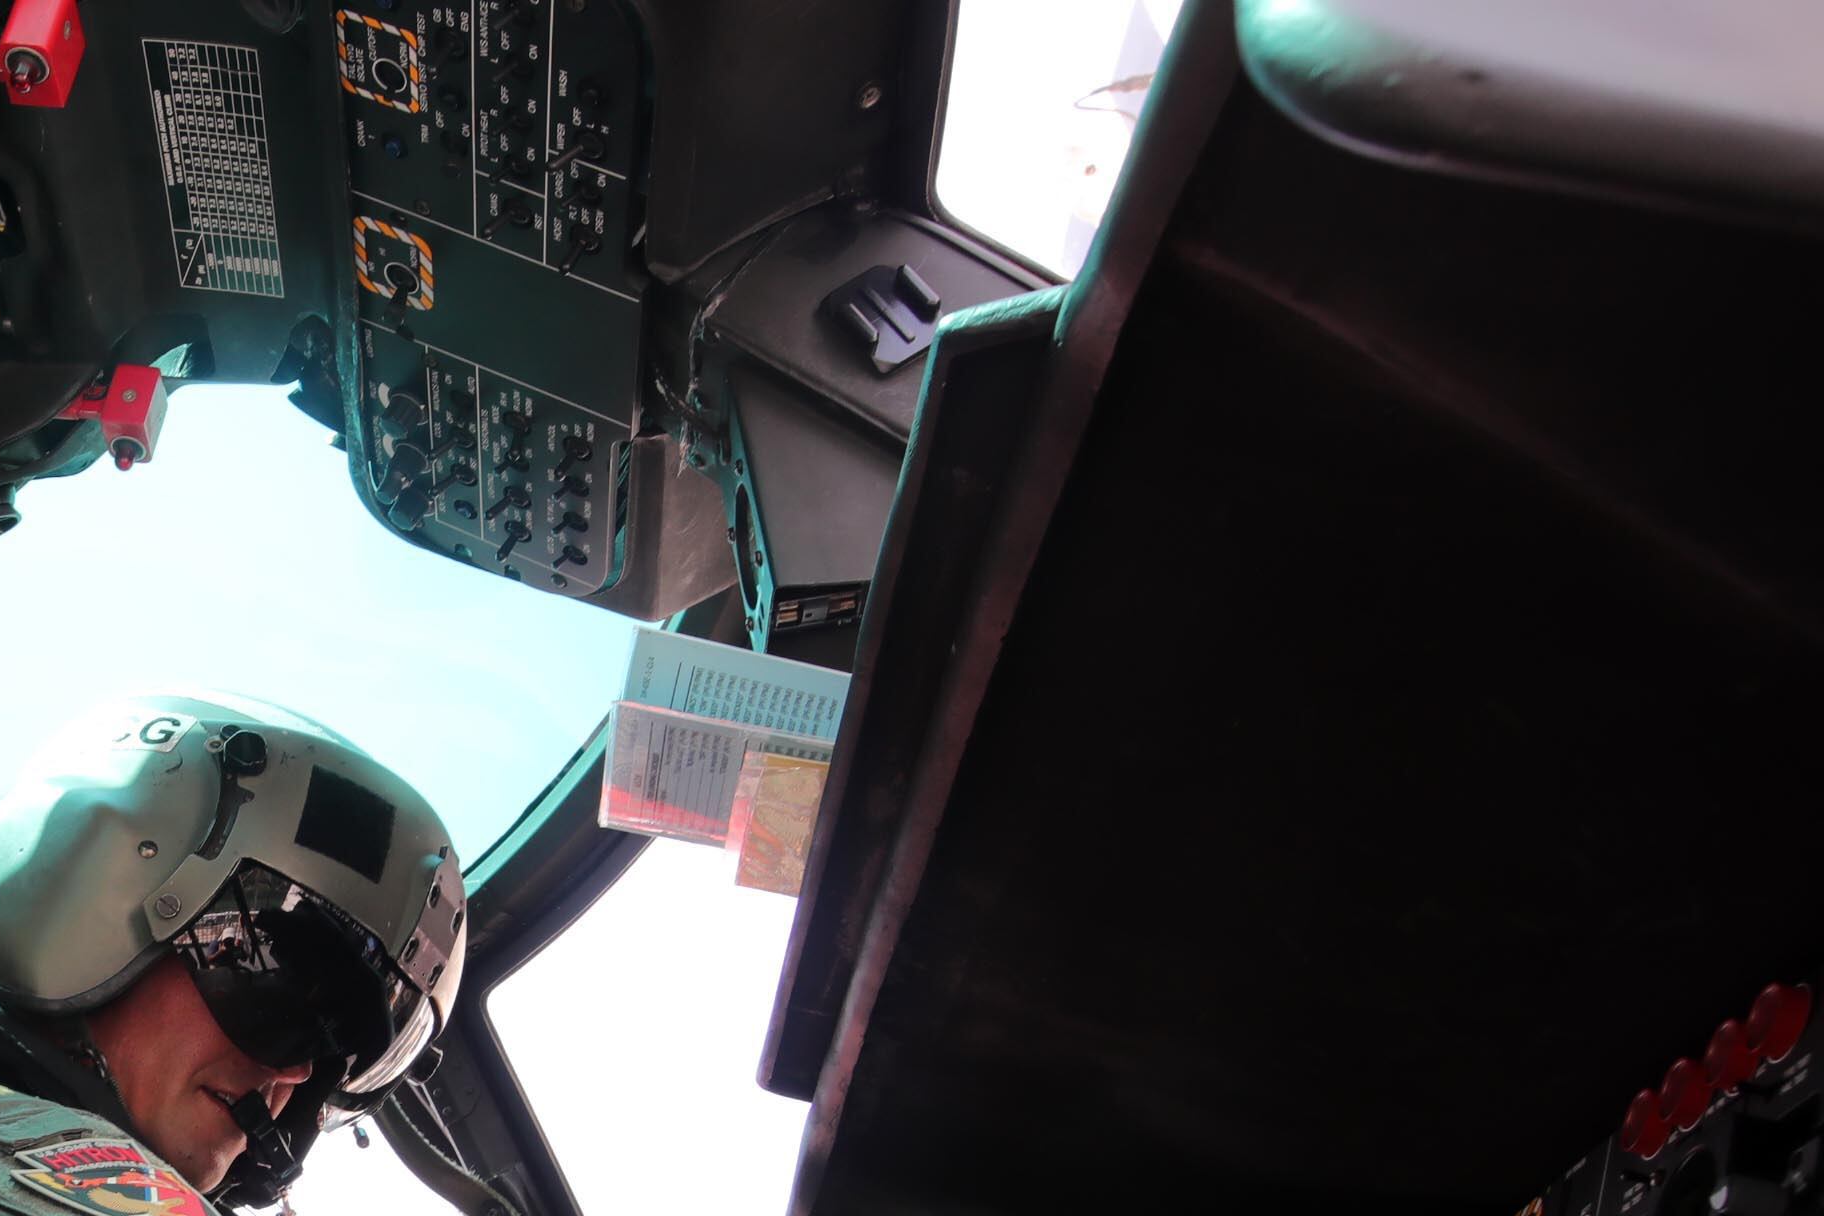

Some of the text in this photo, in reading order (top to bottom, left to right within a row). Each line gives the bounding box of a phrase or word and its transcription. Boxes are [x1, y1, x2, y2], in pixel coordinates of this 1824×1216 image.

[416, 12, 426, 34] TEST
[446, 8, 454, 27] OFF
[460, 11, 469, 32] ENG
[367, 26, 377, 60] CUTOFF
[501, 30, 510, 50] OFF
[399, 42, 408, 68] NORM
[529, 44, 538, 60] ON
[356, 48, 366, 82] ISOLATE
[559, 70, 568, 96] WASH
[419, 84, 429, 112] SERVO
[500, 85, 509, 104] OFF
[528, 99, 536, 114] ON
[436, 110, 444, 128] OFF
[573, 107, 582, 126] OFF
[357, 120, 366, 147] CRANK
[421, 124, 429, 143] TRIM
[461, 123, 470, 137] ON
[557, 123, 566, 149] WIPER
[500, 133, 509, 151] OFF
[527, 147, 535, 162] ON
[597, 173, 607, 187] ON
[581, 208, 590, 225] OFF
[595, 209, 604, 234] CREW
[553, 217, 562, 241] HOIST
